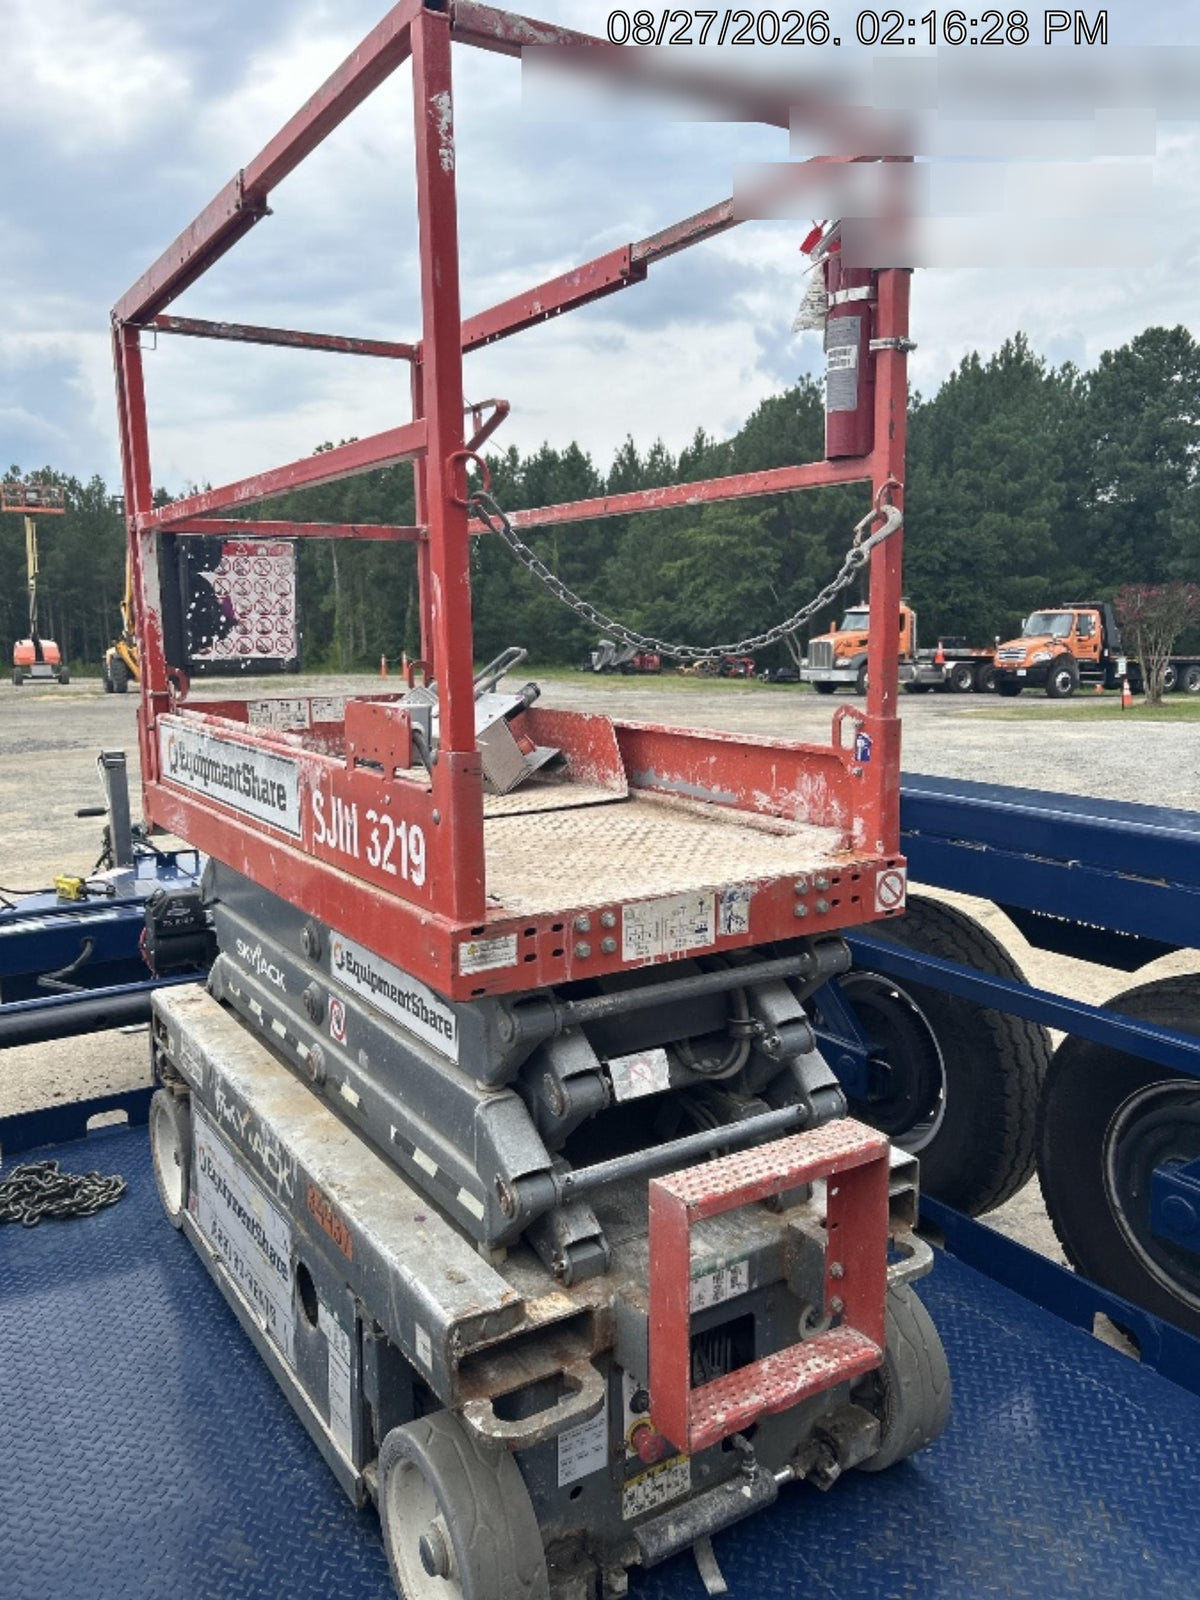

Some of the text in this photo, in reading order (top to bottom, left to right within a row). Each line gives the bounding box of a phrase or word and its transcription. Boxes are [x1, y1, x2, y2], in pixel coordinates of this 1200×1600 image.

[177, 741, 287, 811] EquipmentShare
[365, 809, 426, 886] 3219
[345, 950, 453, 1040] EquipmentShare
